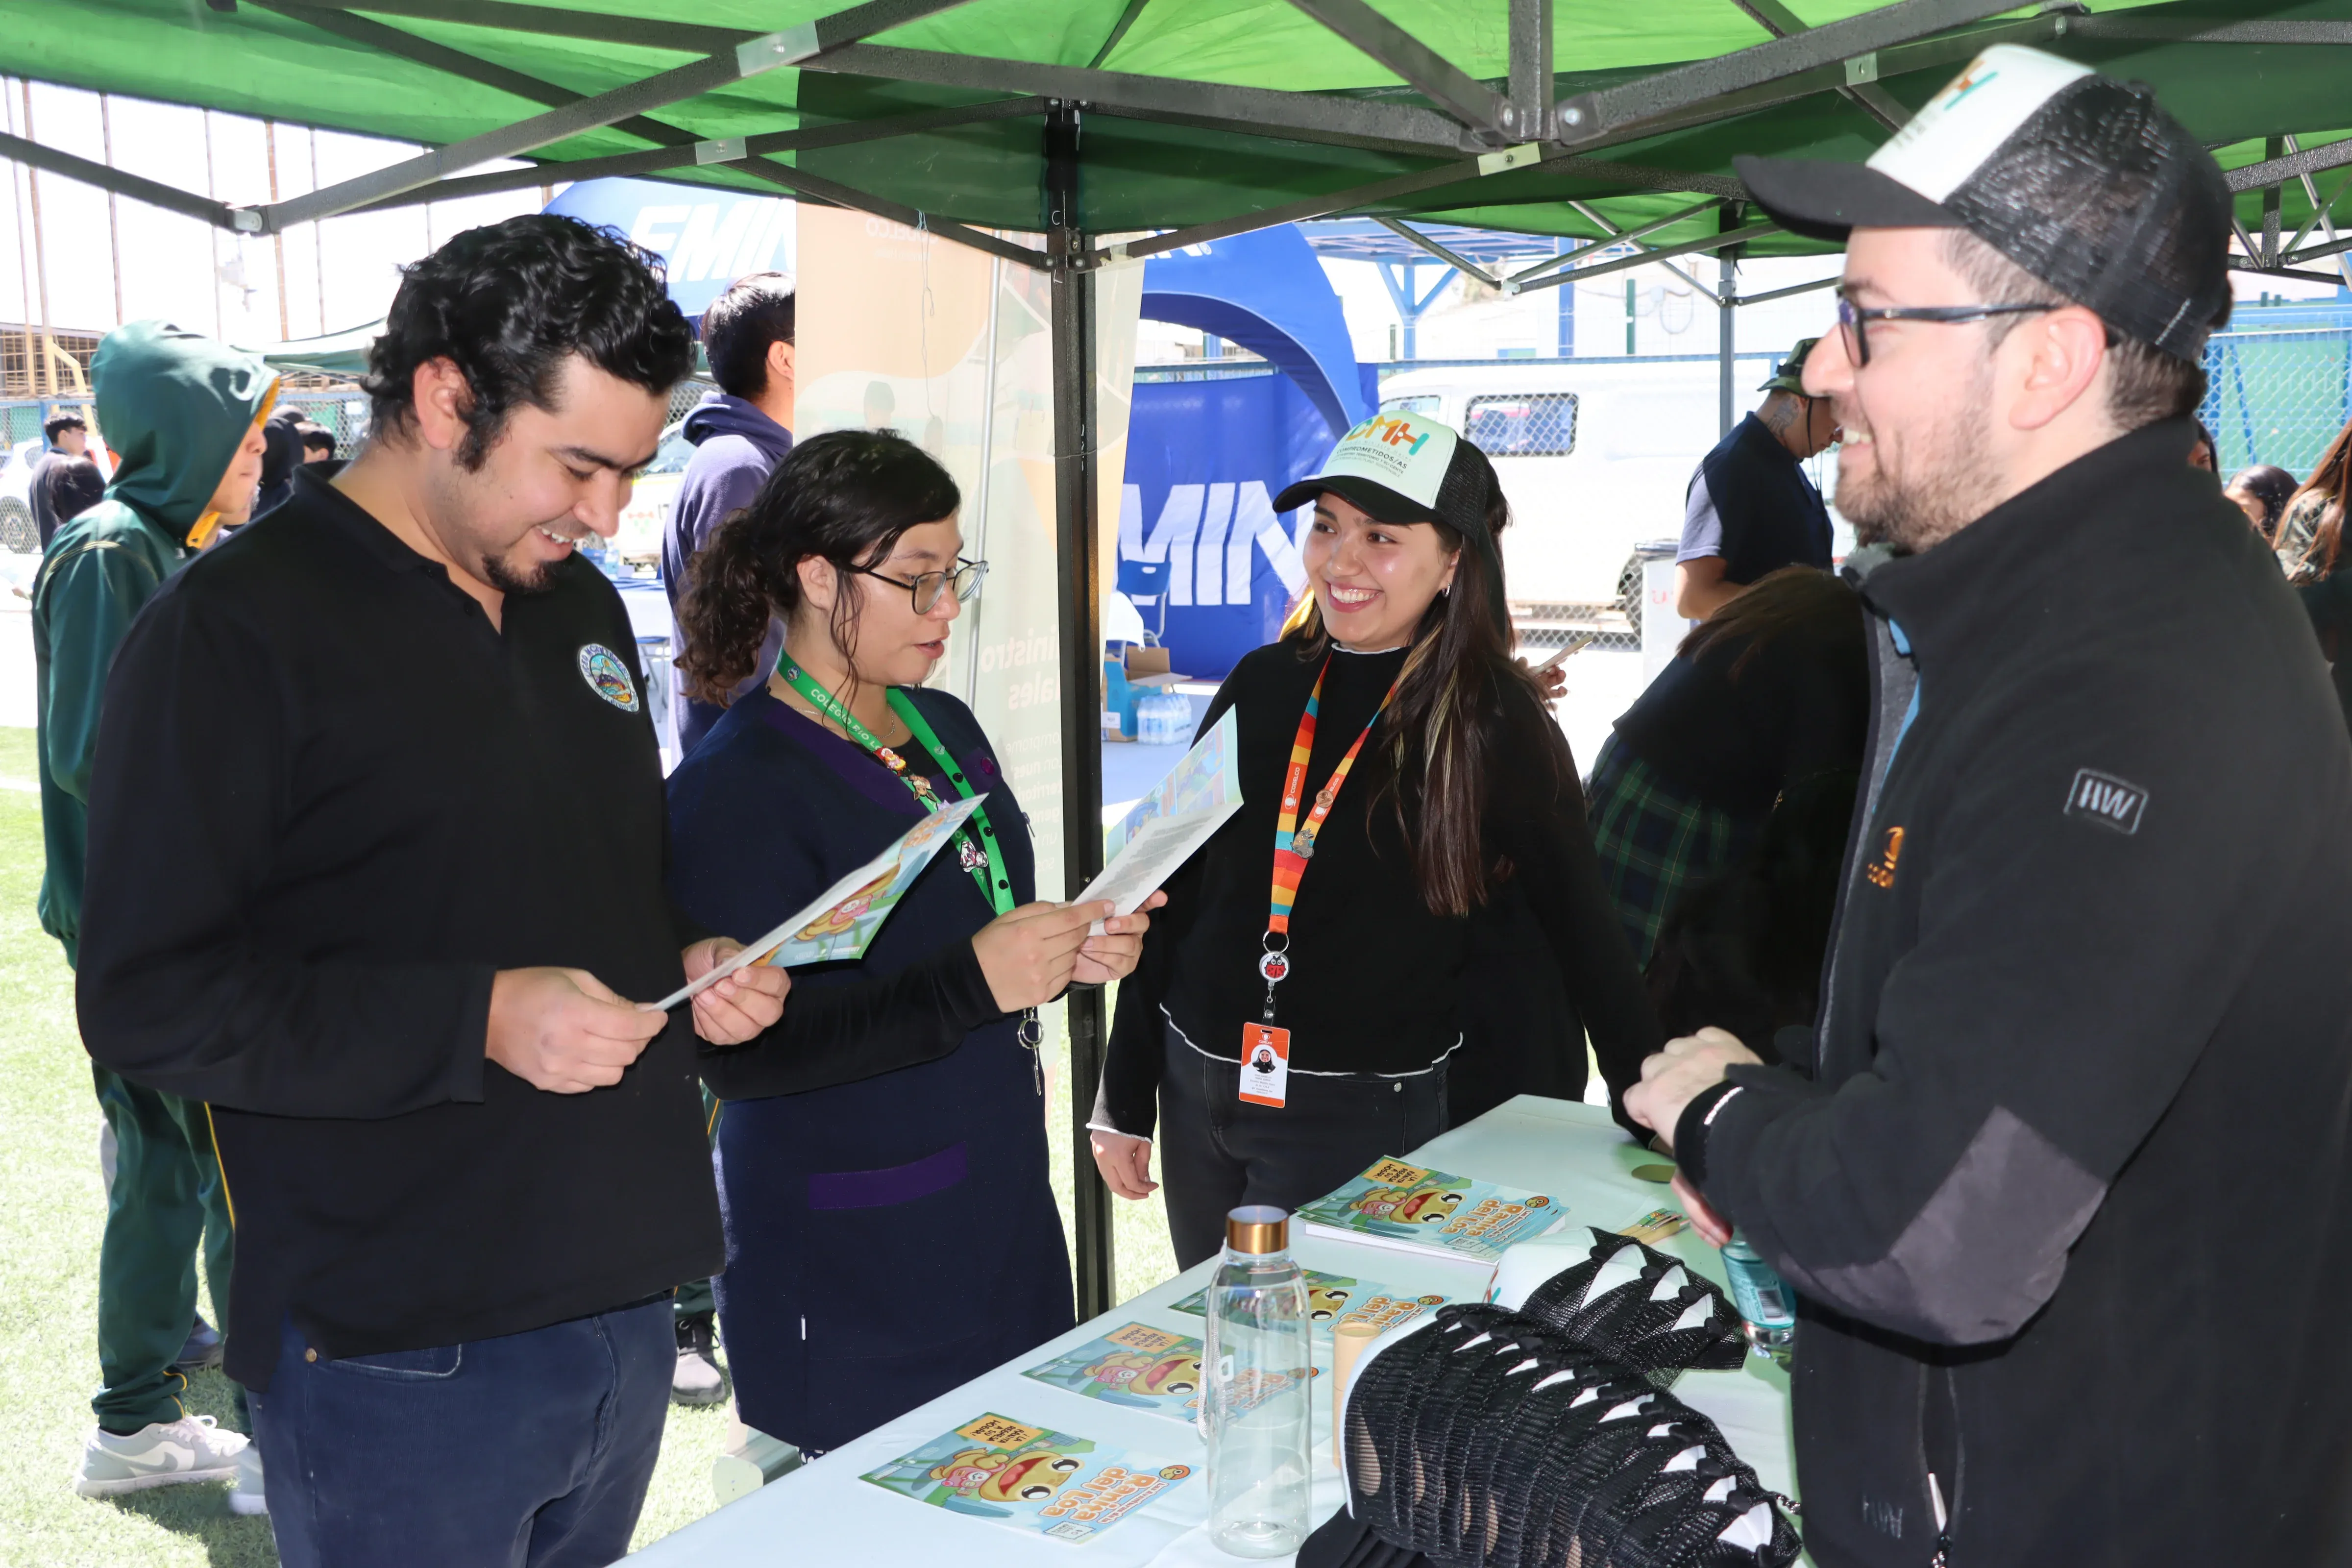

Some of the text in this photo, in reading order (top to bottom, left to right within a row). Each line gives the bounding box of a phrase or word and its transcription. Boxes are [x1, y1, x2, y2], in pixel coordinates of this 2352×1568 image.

[1337, 446, 1408, 469] COMPROMETIDOS/AS
[1390, 464, 1404, 474] GENTE
[1110, 479, 1315, 607] MIN
[810, 688, 853, 726] COLEGIO
[1291, 767, 1300, 794] CODELCO
[1372, 1163, 1396, 1178] HOGAR!
[1387, 1168, 1408, 1182] REGRESA
[1396, 1171, 1415, 1183] RANITA
[1439, 1200, 1500, 1234] del Loa
[1464, 1204, 1525, 1236] Ranita
[1358, 1297, 1390, 1313] del
[1367, 1301, 1417, 1326] Rani
[970, 1420, 1001, 1436] HOGAR!
[986, 1425, 1016, 1442] REGRESA
[997, 1429, 1025, 1443] RANITA
[1040, 1467, 1127, 1516] del Loa
[1069, 1474, 1158, 1520] Ranita
[1153, 1483, 1166, 1492] Las
[1118, 1491, 1153, 1513] Aventuras
